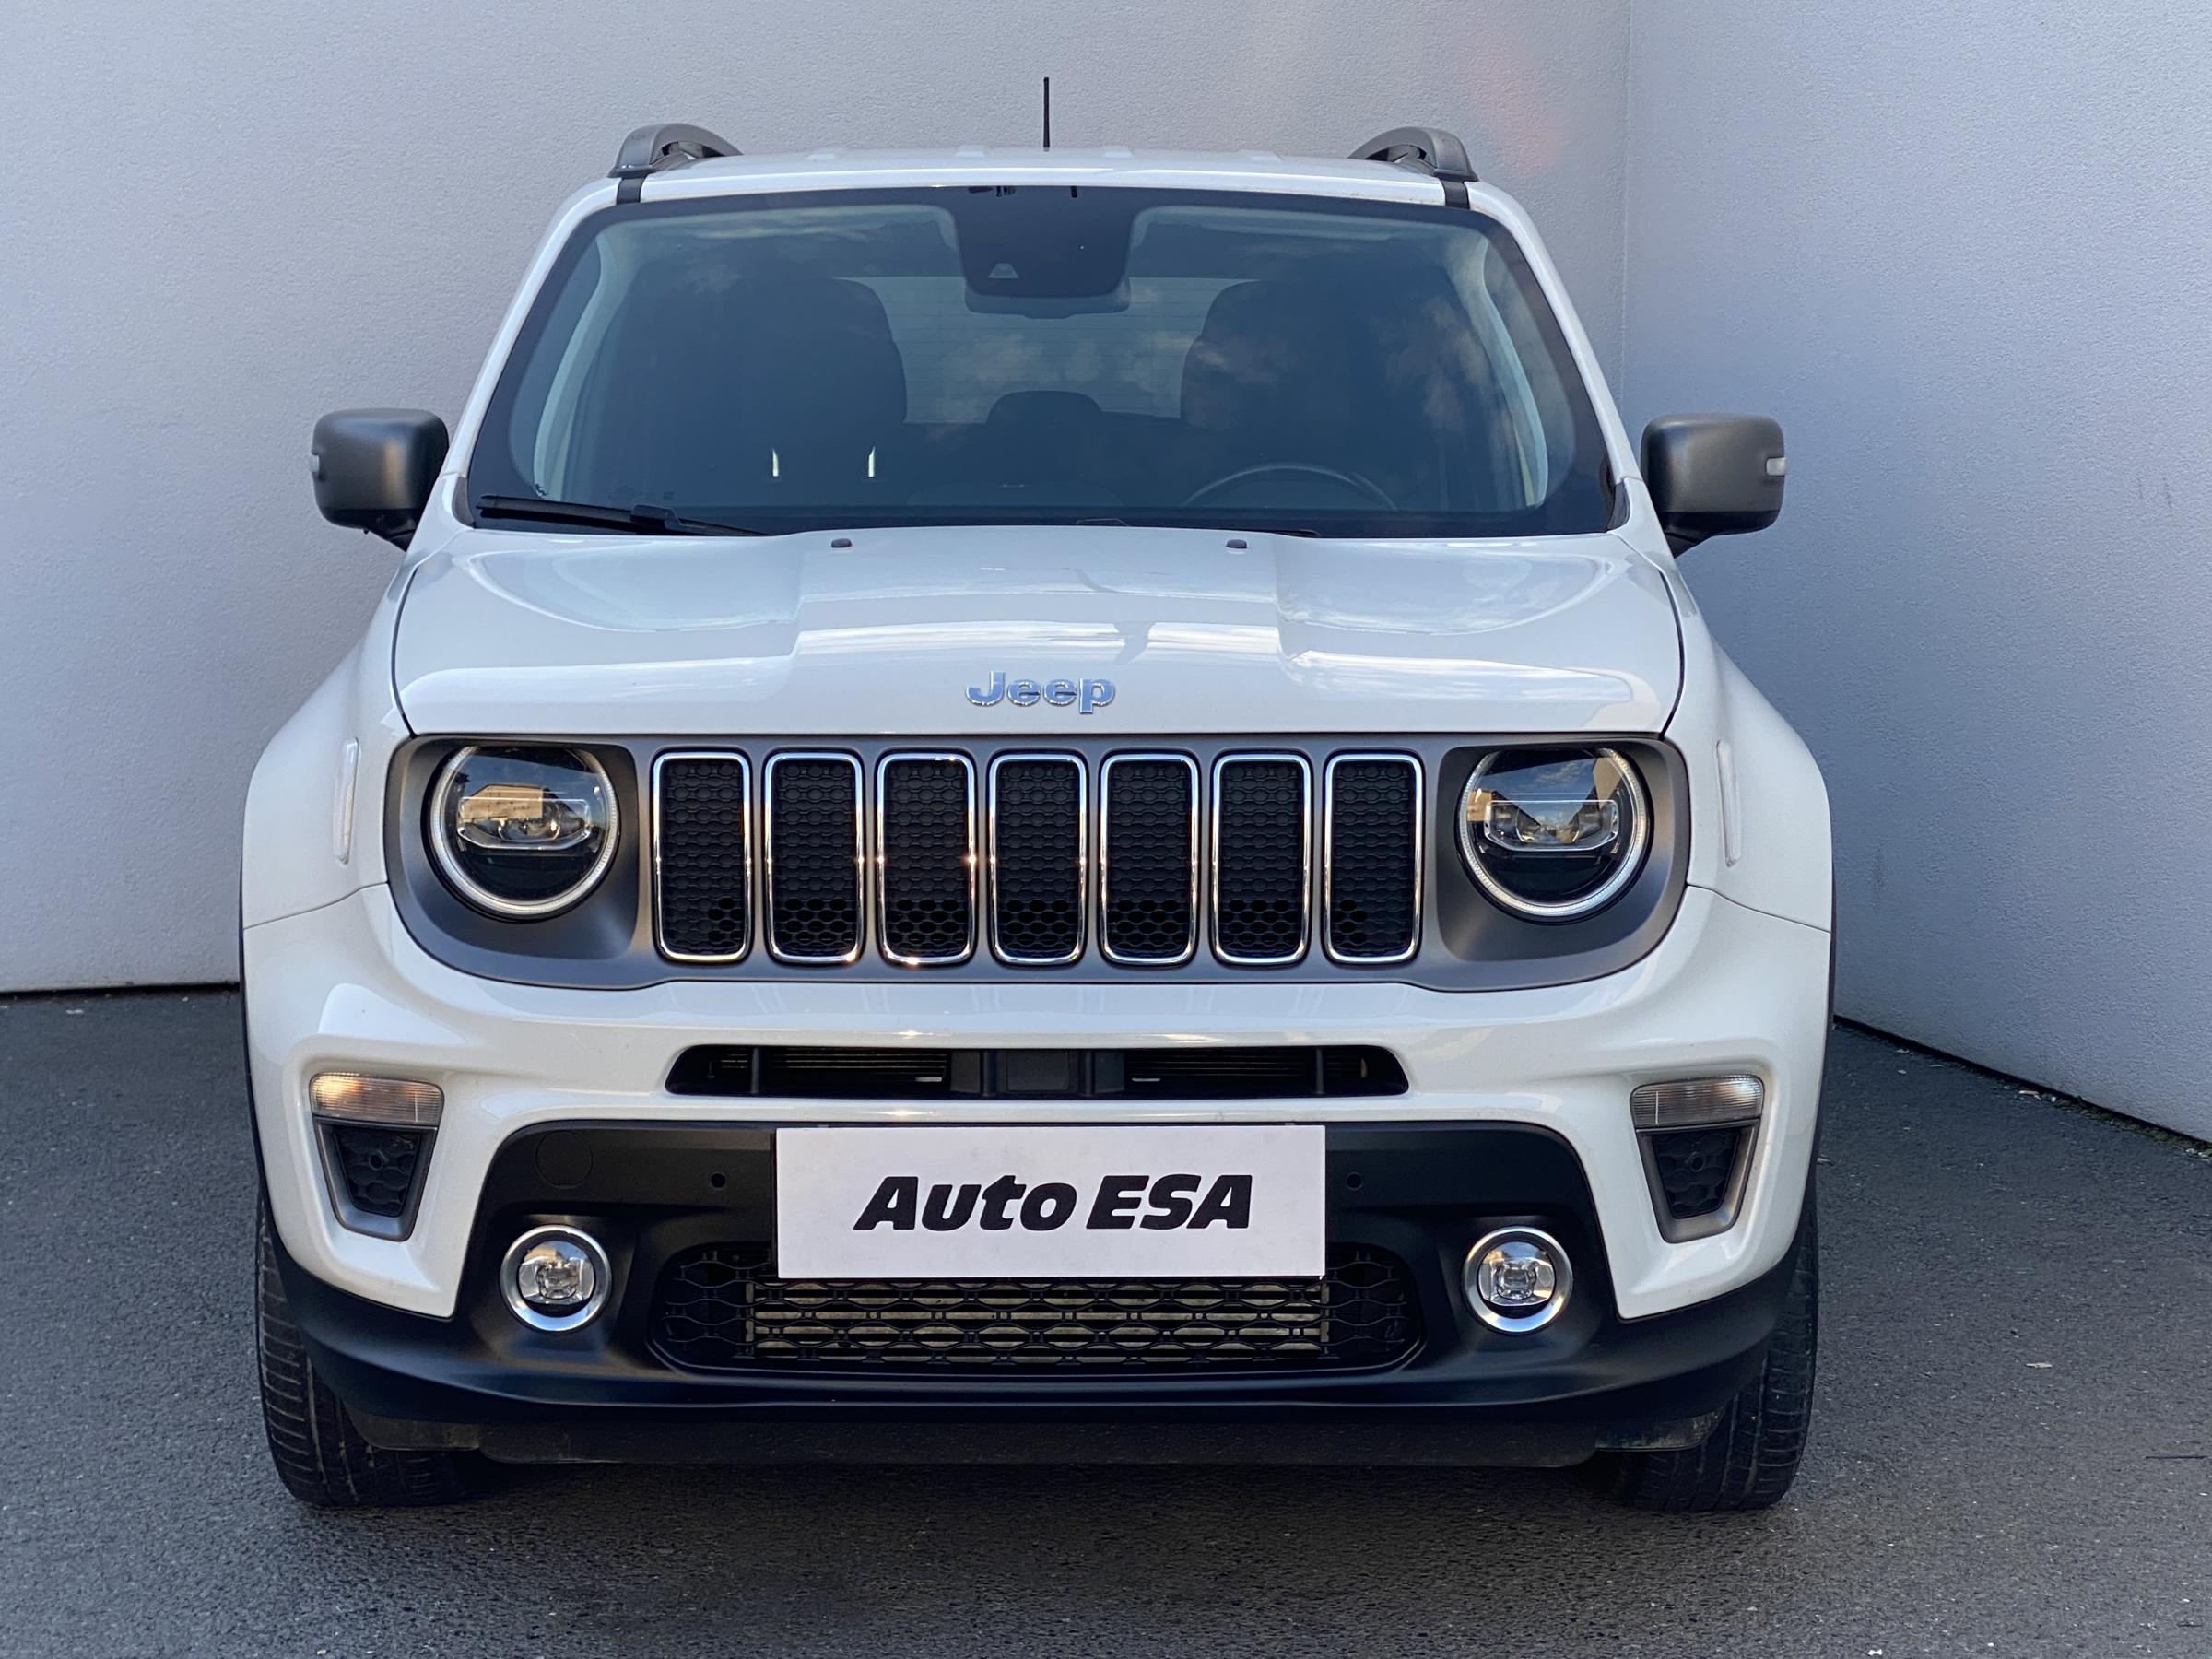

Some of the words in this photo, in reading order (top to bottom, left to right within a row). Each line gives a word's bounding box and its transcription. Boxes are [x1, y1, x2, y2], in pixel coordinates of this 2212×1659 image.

[966, 671, 1116, 715] Jeep
[853, 1174, 1077, 1231] Auto
[1086, 1173, 1252, 1230] ESA
